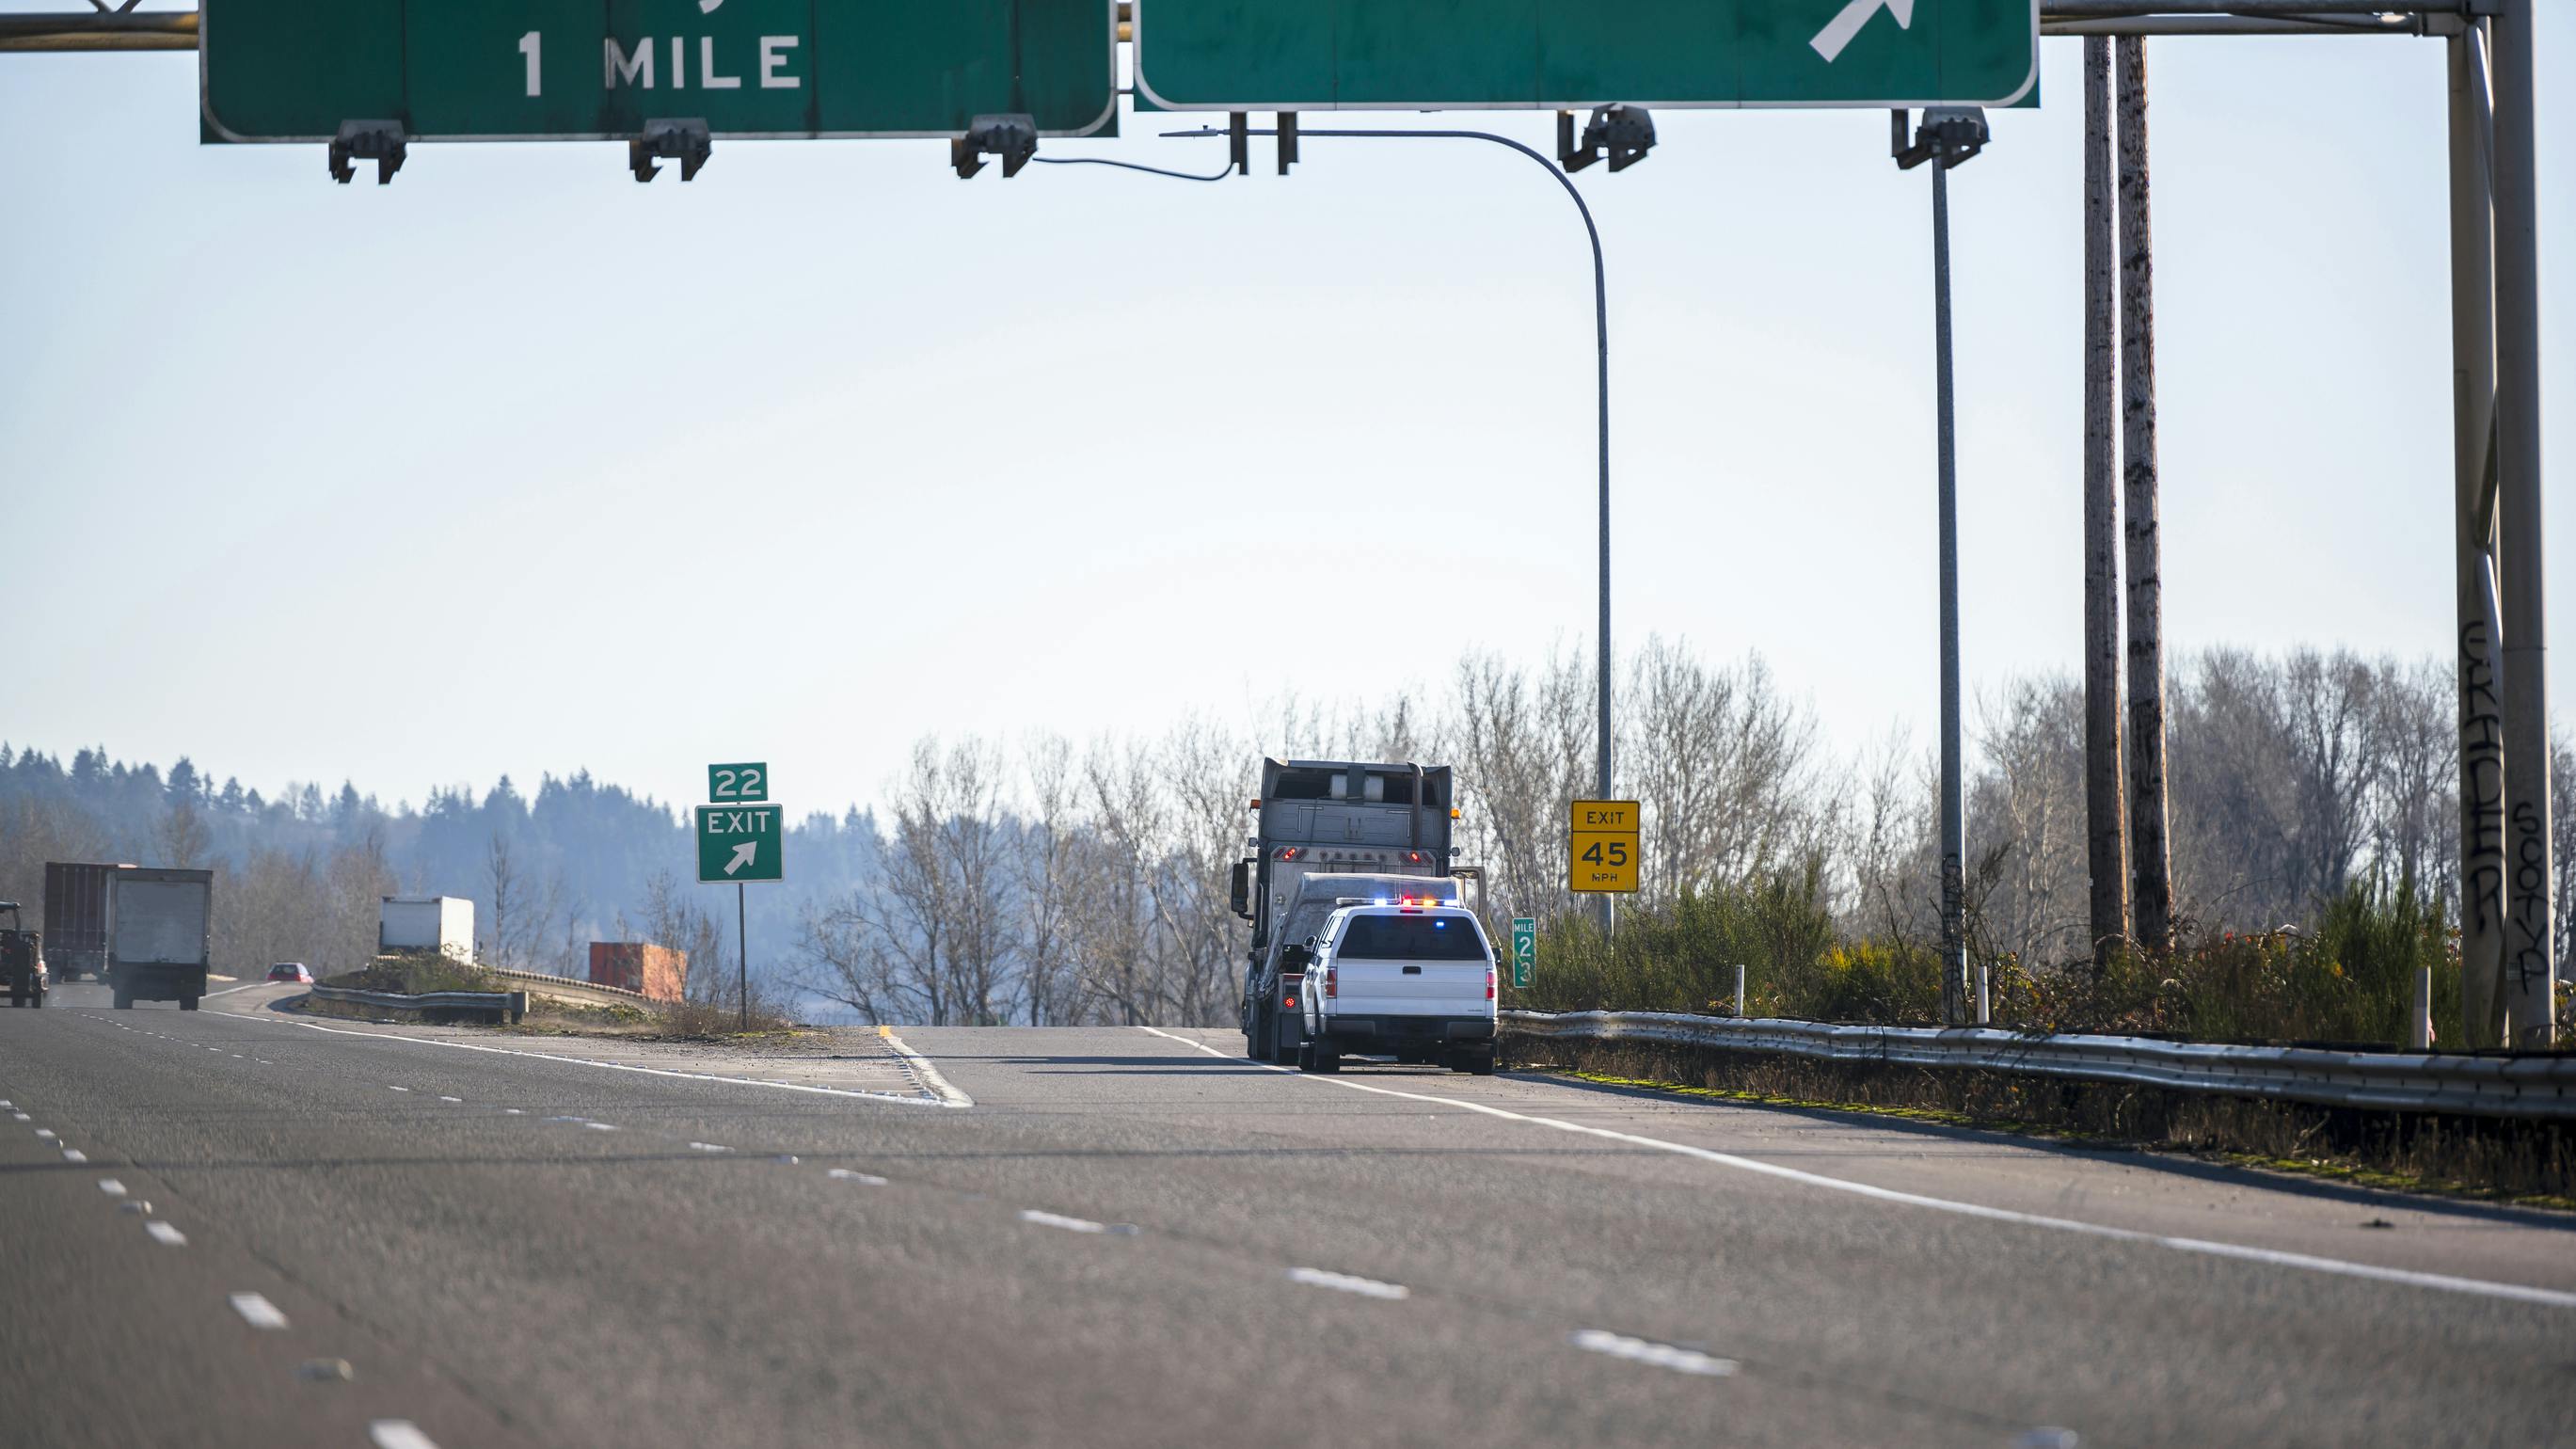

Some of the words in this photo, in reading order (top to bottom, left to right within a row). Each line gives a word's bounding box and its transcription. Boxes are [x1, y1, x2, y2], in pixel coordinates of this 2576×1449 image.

[519, 31, 541, 96] 1
[605, 36, 801, 88] MILE
[715, 769, 762, 796] 22
[708, 811, 771, 834] EXIT
[1586, 811, 1625, 824] EXIT
[1582, 842, 1628, 867] 45
[1591, 873, 1618, 883] MPH
[1514, 923, 1534, 932] MILE
